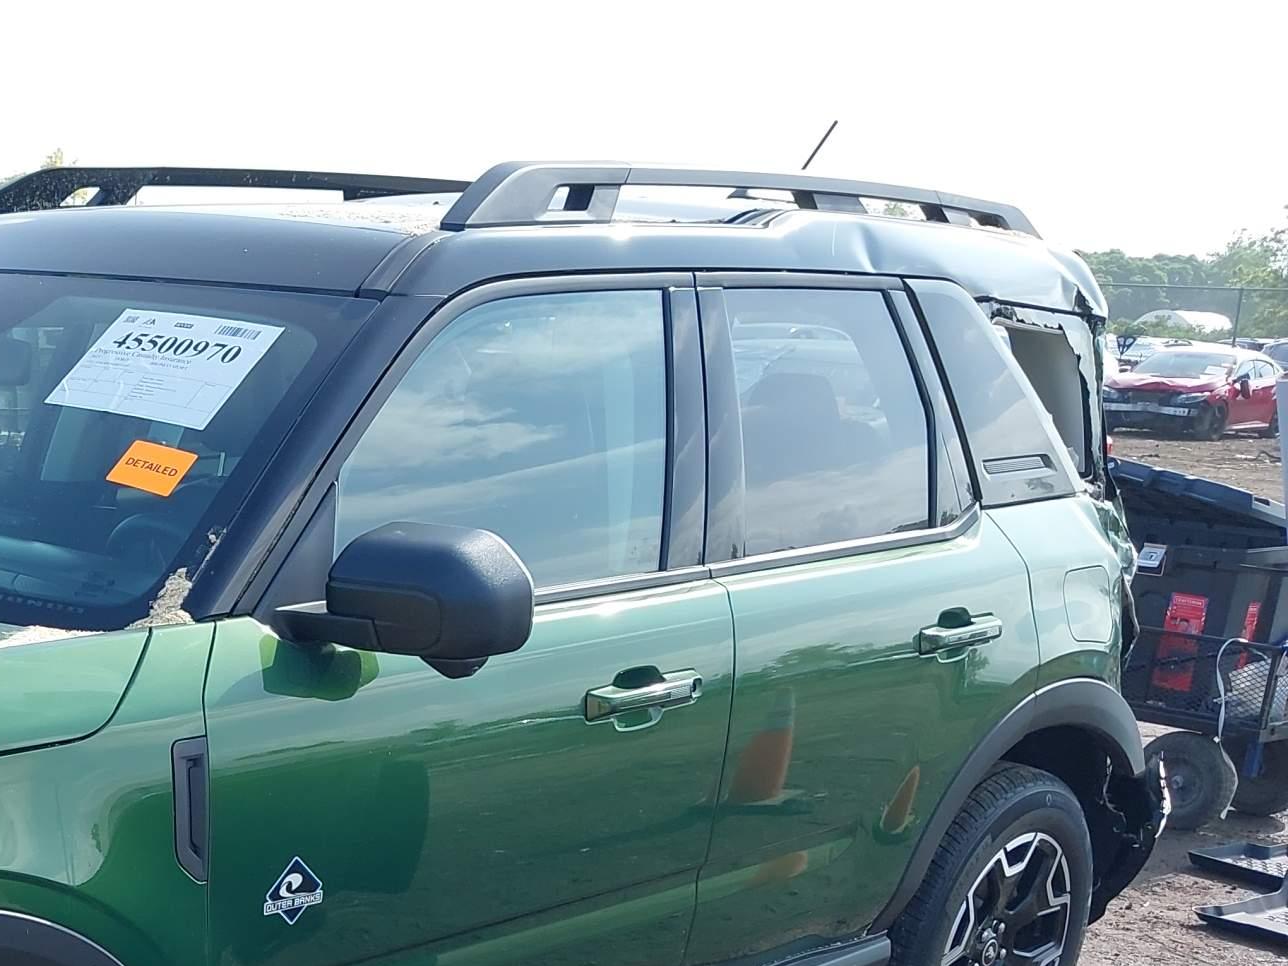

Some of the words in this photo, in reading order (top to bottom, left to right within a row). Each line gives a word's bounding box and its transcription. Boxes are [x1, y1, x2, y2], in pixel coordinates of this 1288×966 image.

[113, 332, 242, 364] 45500970
[125, 457, 178, 477] DETAILED
[266, 900, 292, 912] OUTER
[294, 893, 320, 906] BANKS
